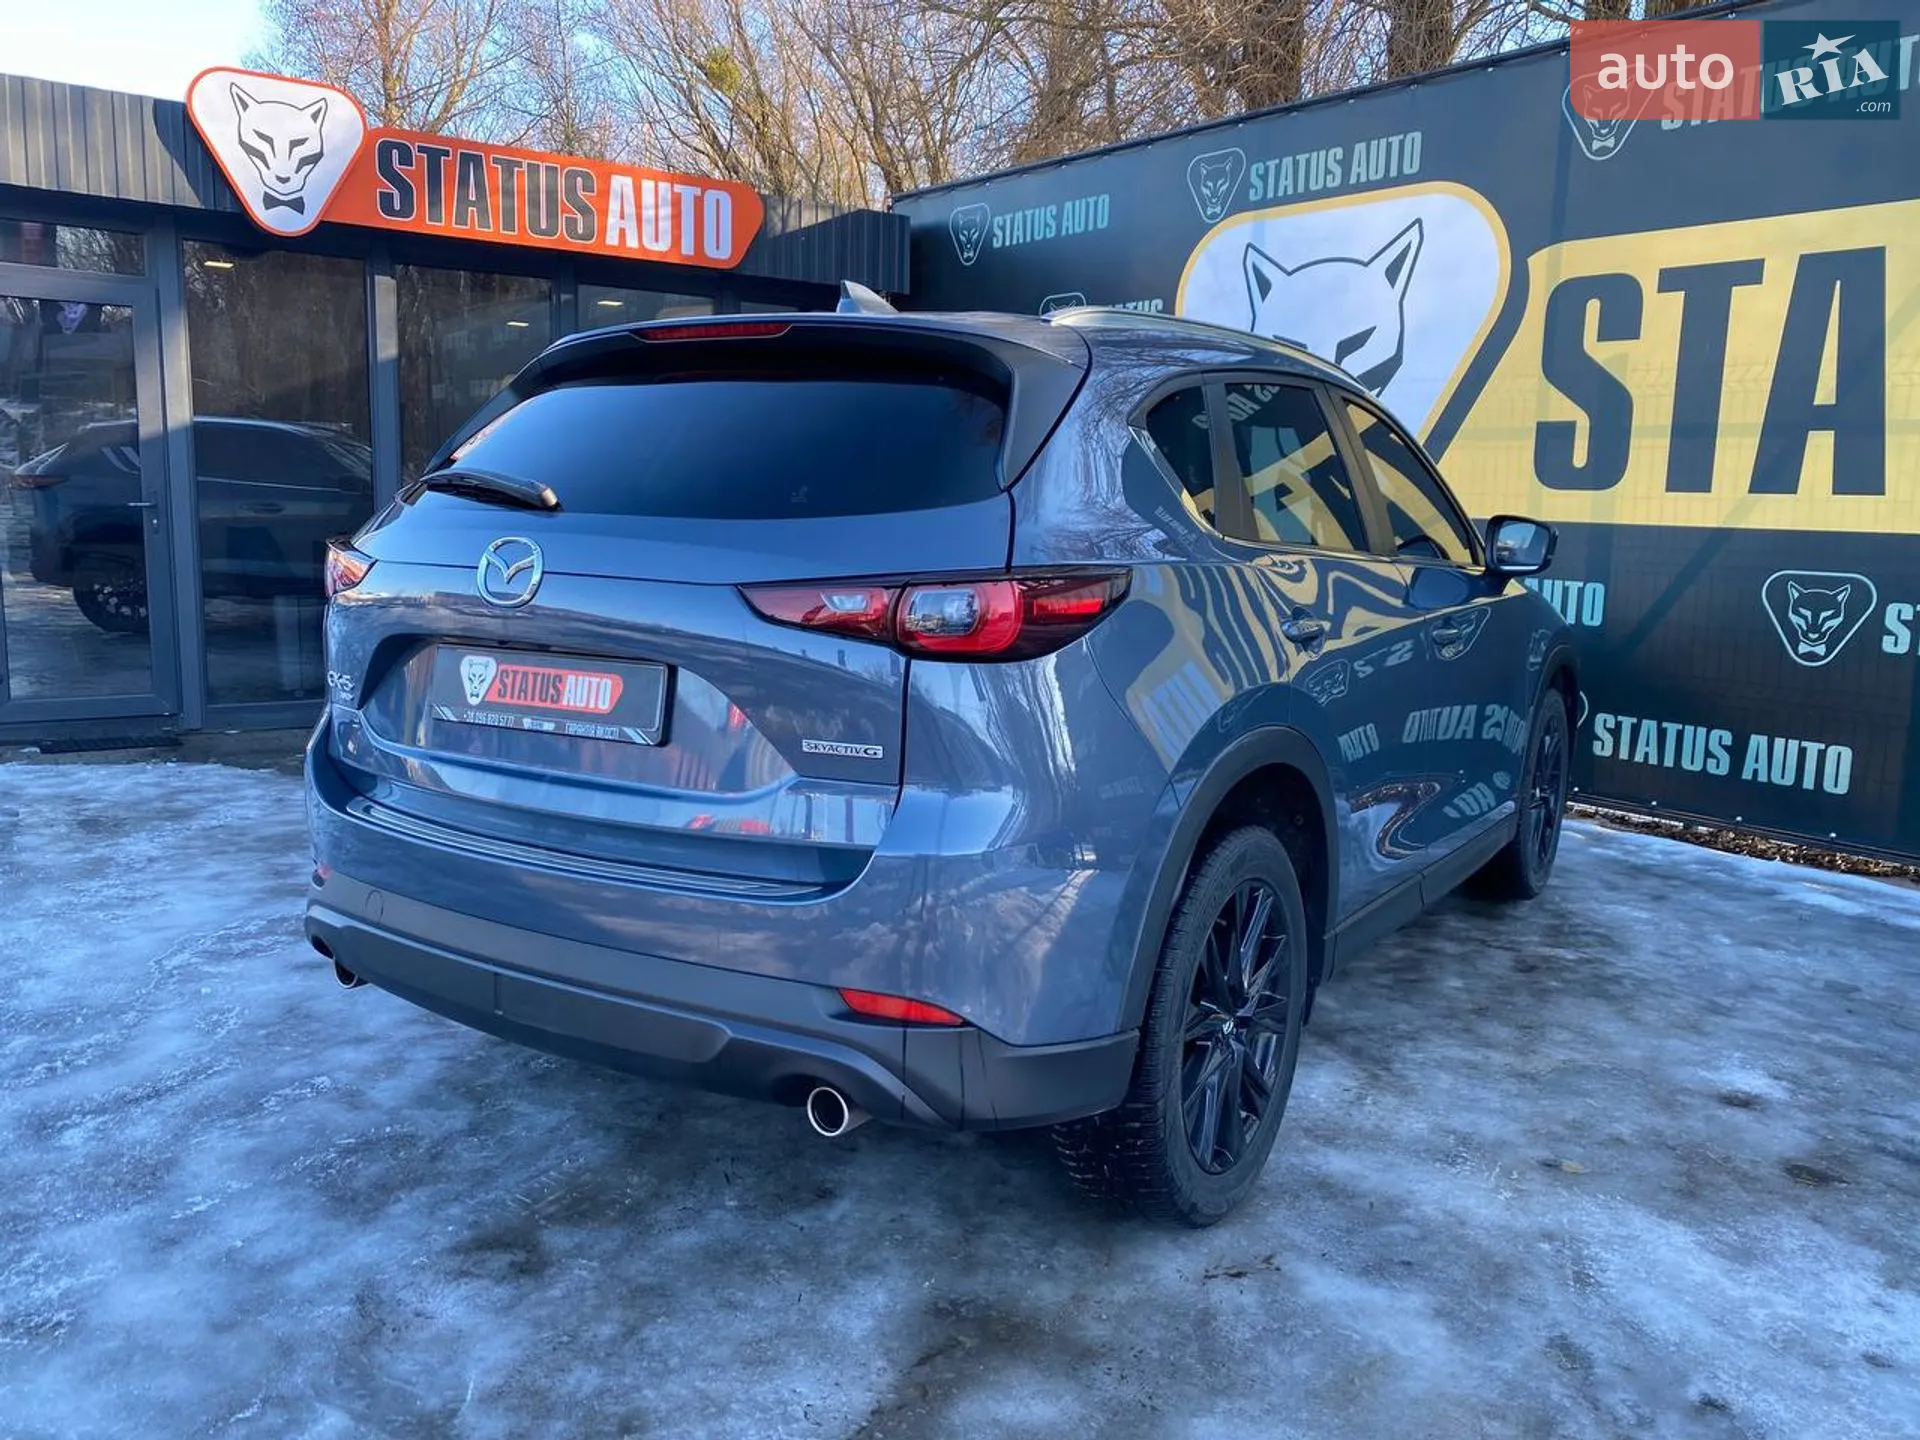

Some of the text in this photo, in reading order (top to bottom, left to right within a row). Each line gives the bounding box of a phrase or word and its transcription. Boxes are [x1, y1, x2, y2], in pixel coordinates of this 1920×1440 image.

[375, 138, 733, 261] STATUS AUTO
[1249, 131, 1422, 201] STATUS AUTO
[992, 194, 1110, 248] STATUS AUTO
[1533, 245, 1887, 496] STA
[1881, 602, 1920, 656] S
[497, 669, 612, 710] STATUS AUTO
[1592, 712, 1733, 777] STATUS
[1741, 733, 1853, 795] AUTO
